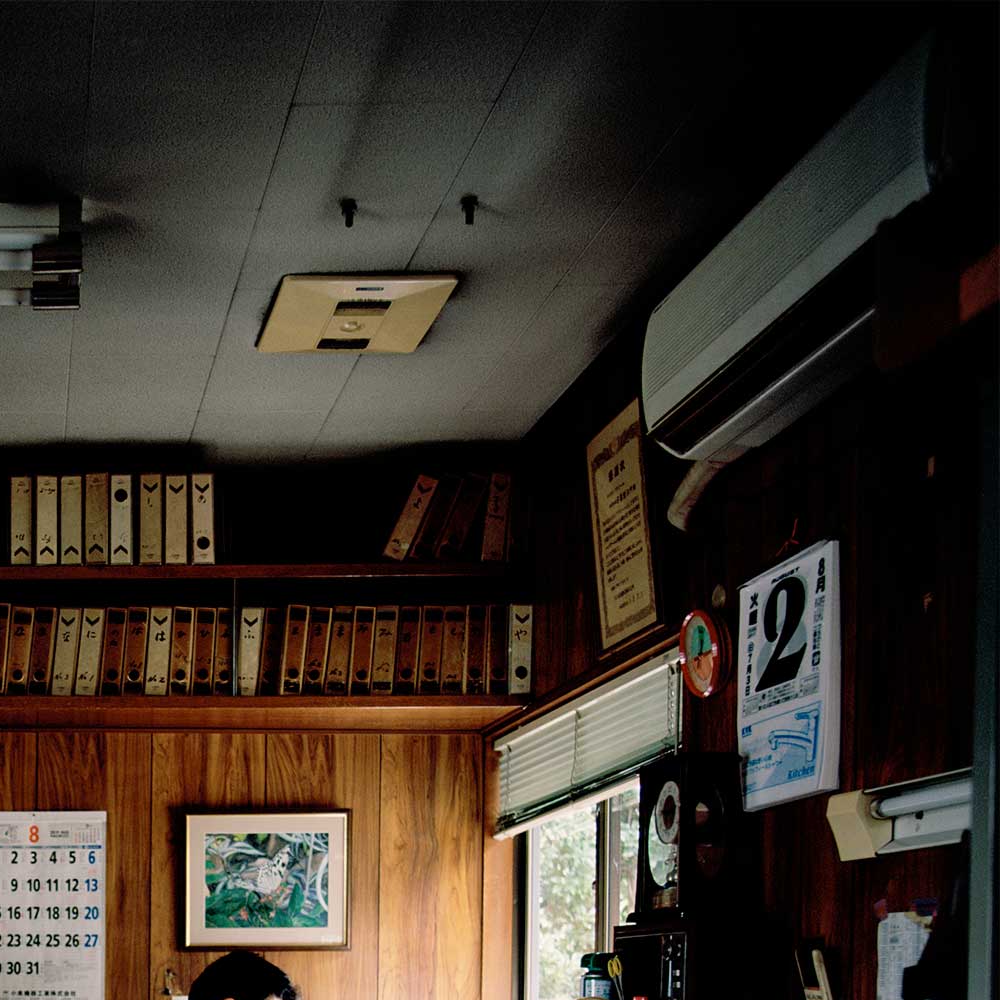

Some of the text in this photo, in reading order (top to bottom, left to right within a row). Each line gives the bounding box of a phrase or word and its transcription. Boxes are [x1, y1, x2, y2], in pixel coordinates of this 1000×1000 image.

[772, 567, 800, 584] AUGUST
[86, 629, 97, 639] に
[155, 630, 167, 642] は
[514, 629, 528, 641] や
[755, 577, 807, 692] 2
[788, 766, 815, 780] Kitchen
[29, 825, 39, 843] 8
[11, 851, 18, 864] 2
[31, 851, 37, 864] 3
[50, 851, 57, 864] 4
[70, 851, 76, 864] 5
[88, 851, 95, 864] 6
[11, 879, 18, 892] 9
[27, 879, 40, 892] 10
[47, 879, 58, 891] 11
[66, 879, 78, 891] 12
[85, 879, 98, 891] 13
[8, 906, 21, 919] 16
[27, 907, 40, 919] 17
[46, 906, 59, 920] 18
[66, 906, 79, 919] 19
[85, 906, 99, 919] 20
[7, 934, 21, 947] 23
[26, 934, 40, 947] 24
[46, 934, 60, 947] 25
[65, 934, 79, 947] 26
[84, 934, 98, 947] 27
[7, 962, 21, 975] 30
[27, 962, 39, 974] 31
